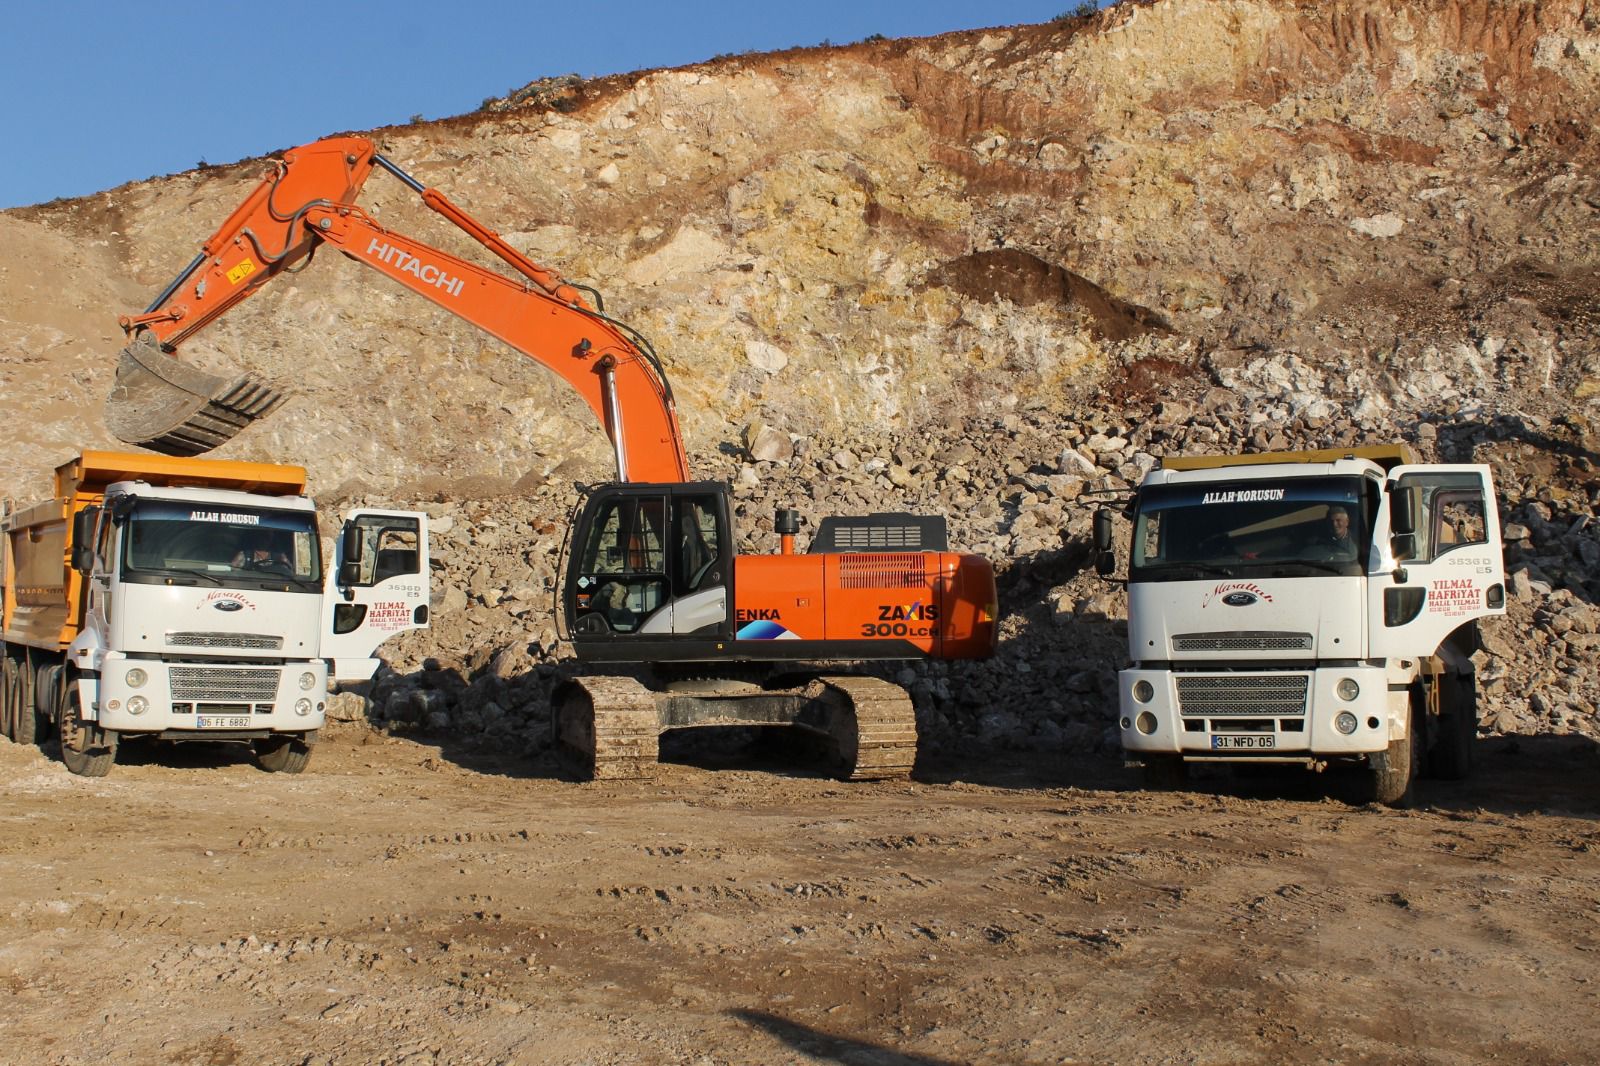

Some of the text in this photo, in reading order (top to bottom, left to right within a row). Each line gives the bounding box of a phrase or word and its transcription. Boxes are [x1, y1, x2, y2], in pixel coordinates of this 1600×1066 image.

[366, 238, 465, 297] HITACHI
[1202, 489, 1285, 504] ALLAH KORUSUN
[190, 511, 260, 525] ALLAH KORUSUN
[1476, 566, 1493, 574] E5
[1433, 579, 1473, 590] YILMAZ
[374, 602, 406, 610] YILMAZ
[878, 601, 939, 621] ZAXIS
[736, 608, 781, 621] ENKA
[861, 623, 939, 637] 300 LCH
[201, 718, 212, 727] 06
[215, 718, 225, 727] FE
[1216, 736, 1273, 748] 31 NFD 05
